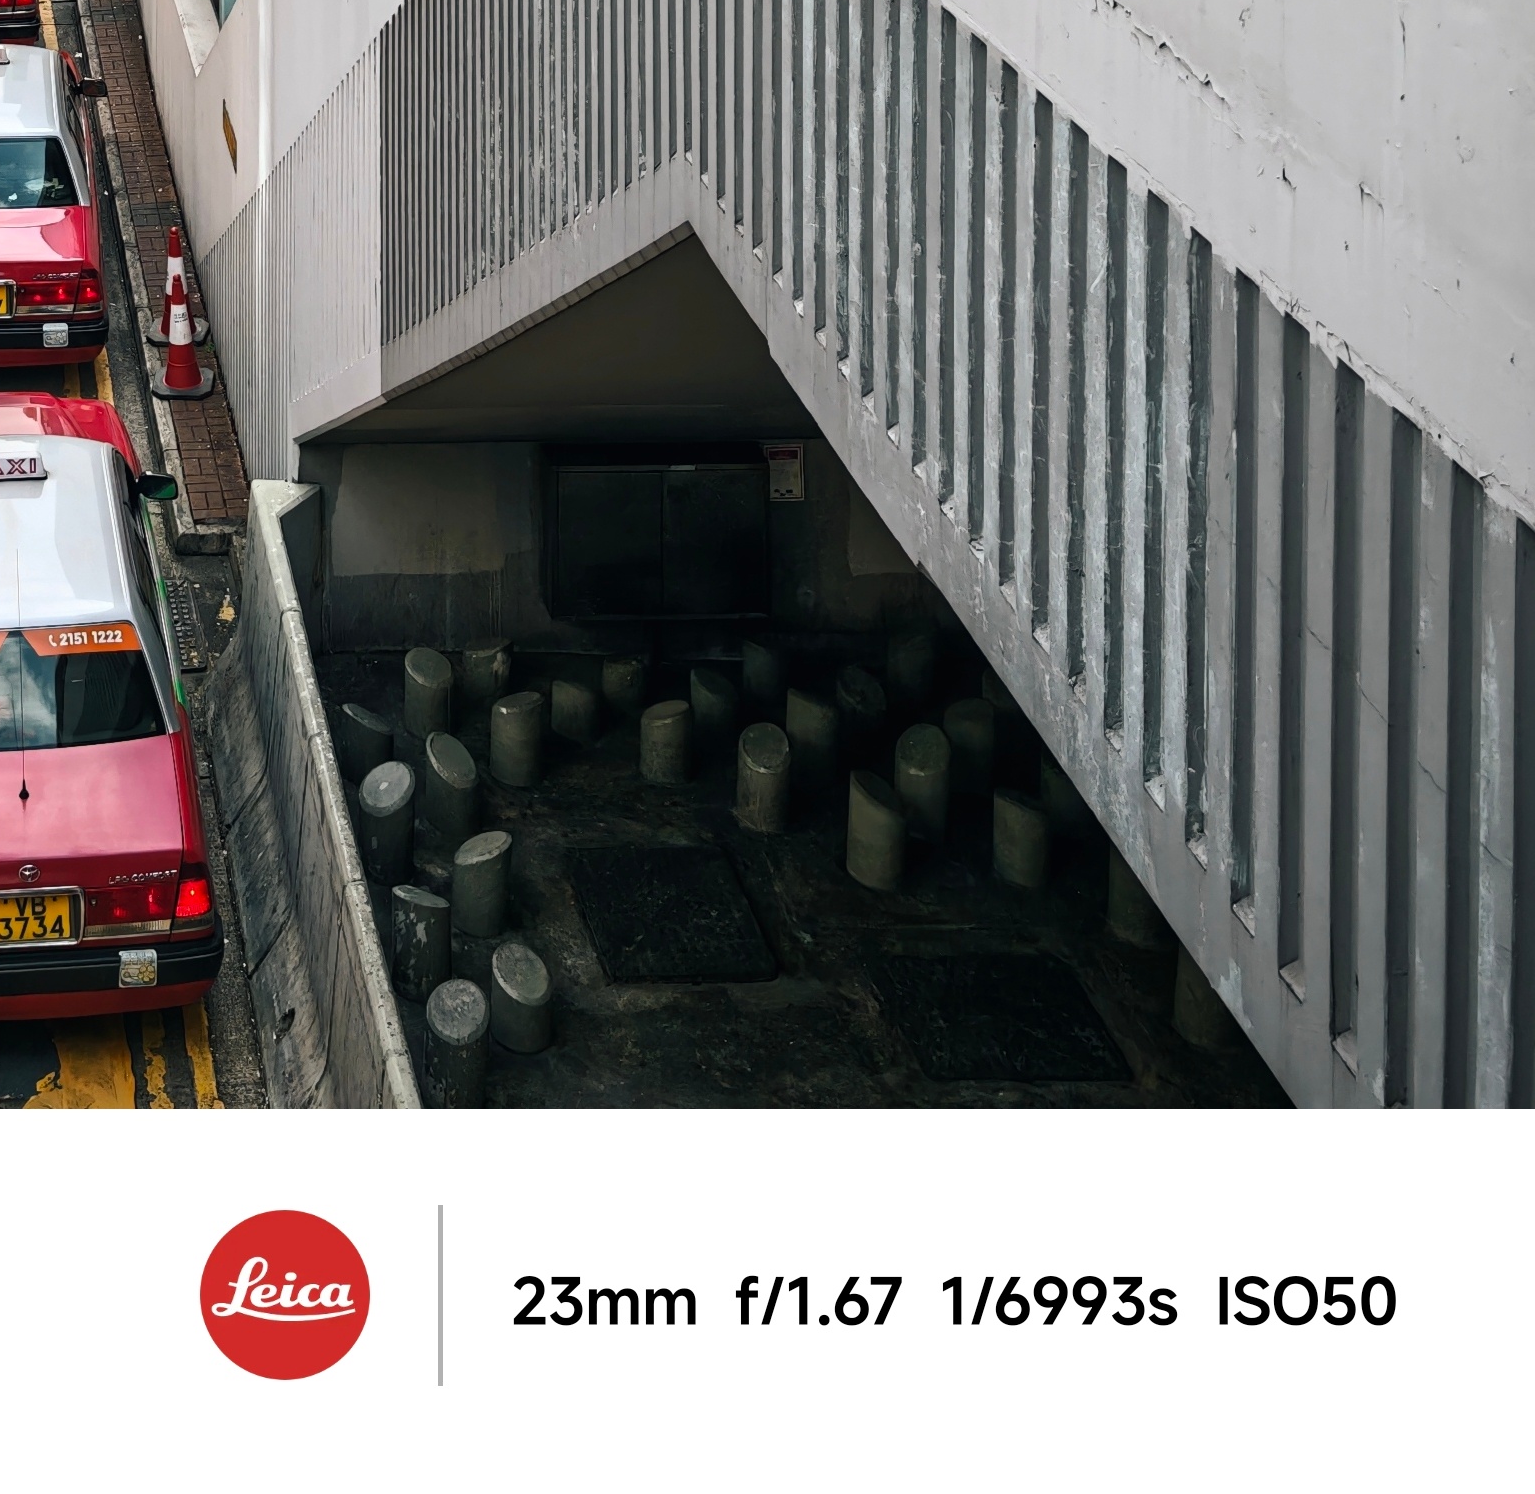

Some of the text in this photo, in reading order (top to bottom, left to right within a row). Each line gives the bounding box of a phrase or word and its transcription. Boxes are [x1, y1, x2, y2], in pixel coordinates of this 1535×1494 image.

[59, 631, 88, 647] 2151
[91, 628, 123, 645] 1222
[131, 869, 178, 884] COMFORT
[14, 897, 47, 917] VB
